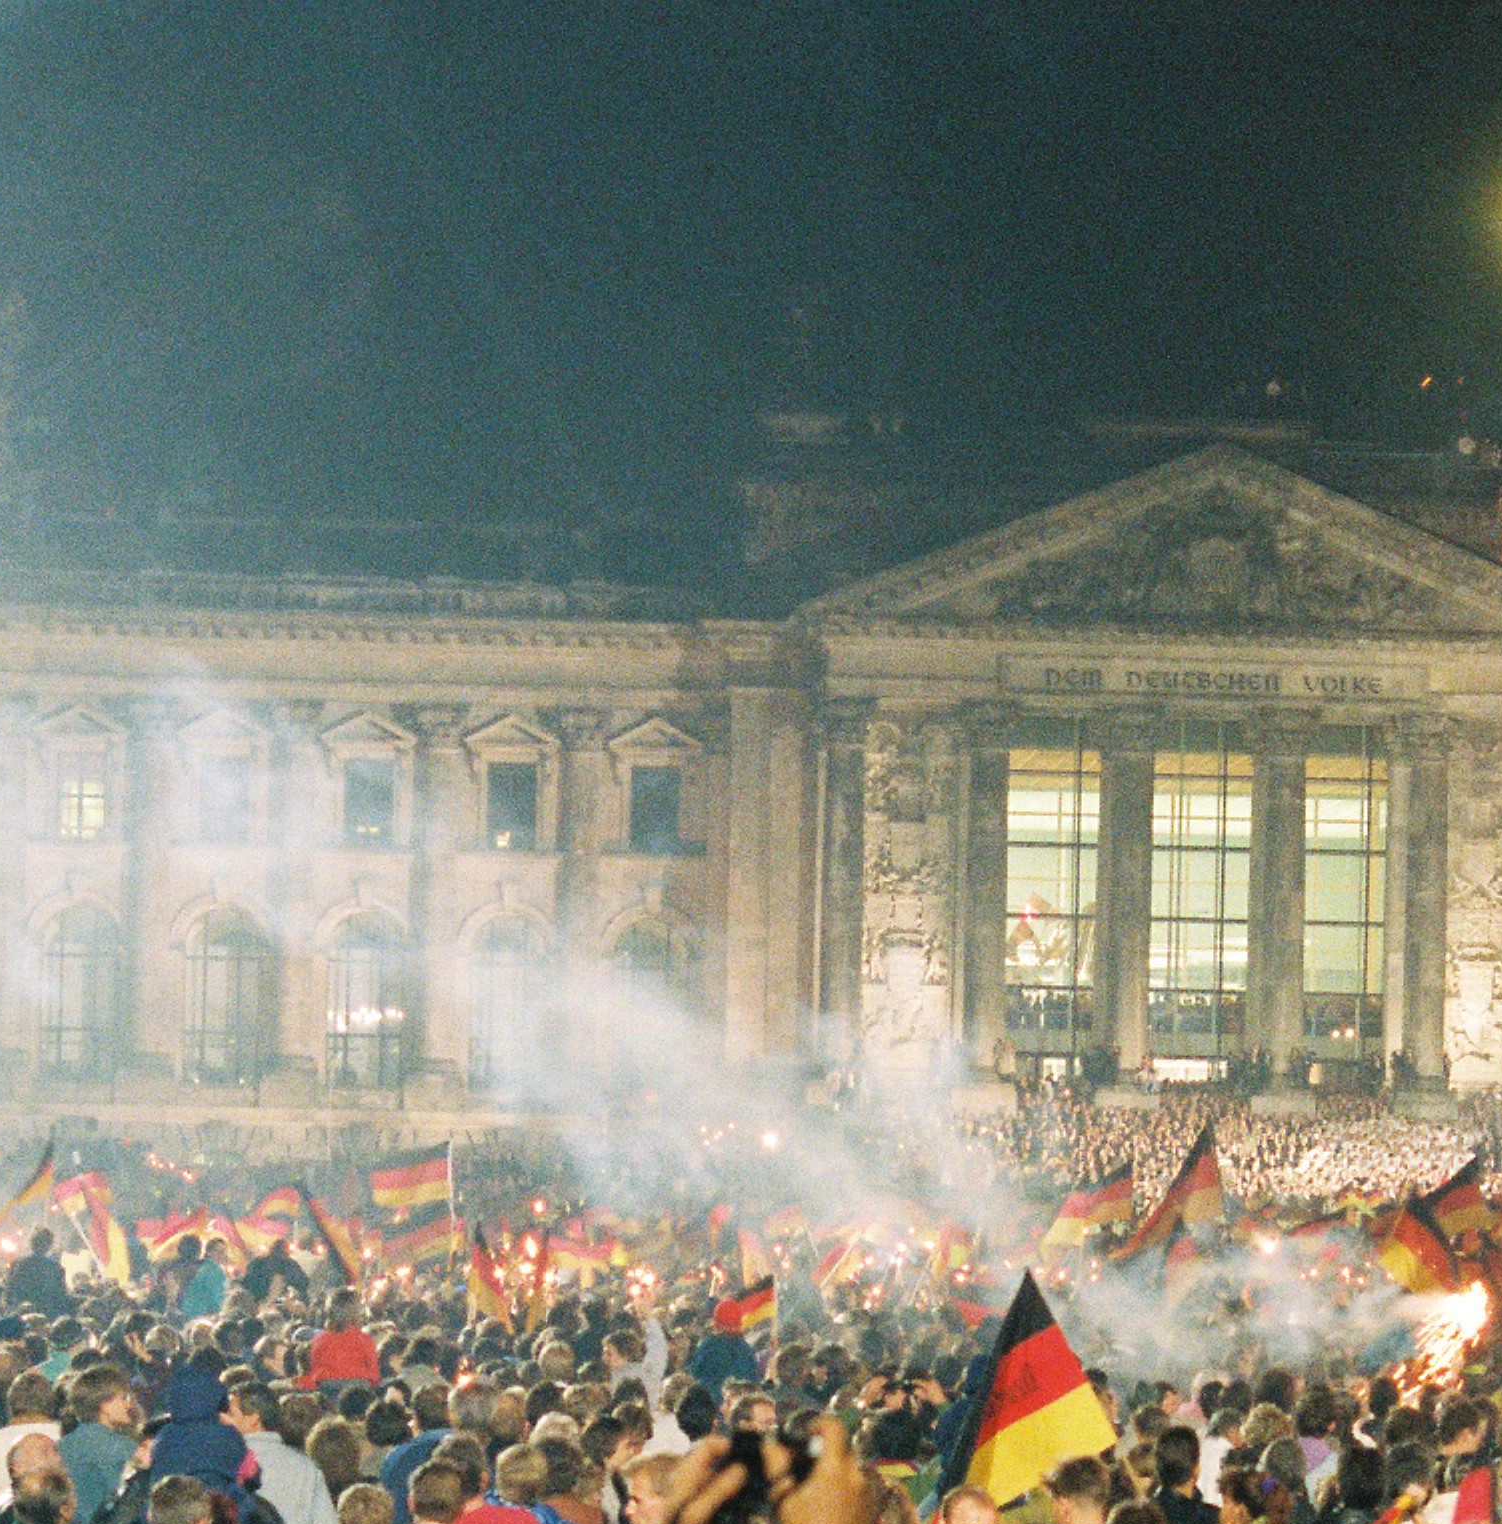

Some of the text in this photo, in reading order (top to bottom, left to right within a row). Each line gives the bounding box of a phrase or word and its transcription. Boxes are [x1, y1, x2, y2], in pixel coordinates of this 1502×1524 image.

[1043, 667, 1383, 694] DEM DEUTSCHEN VOLKE
